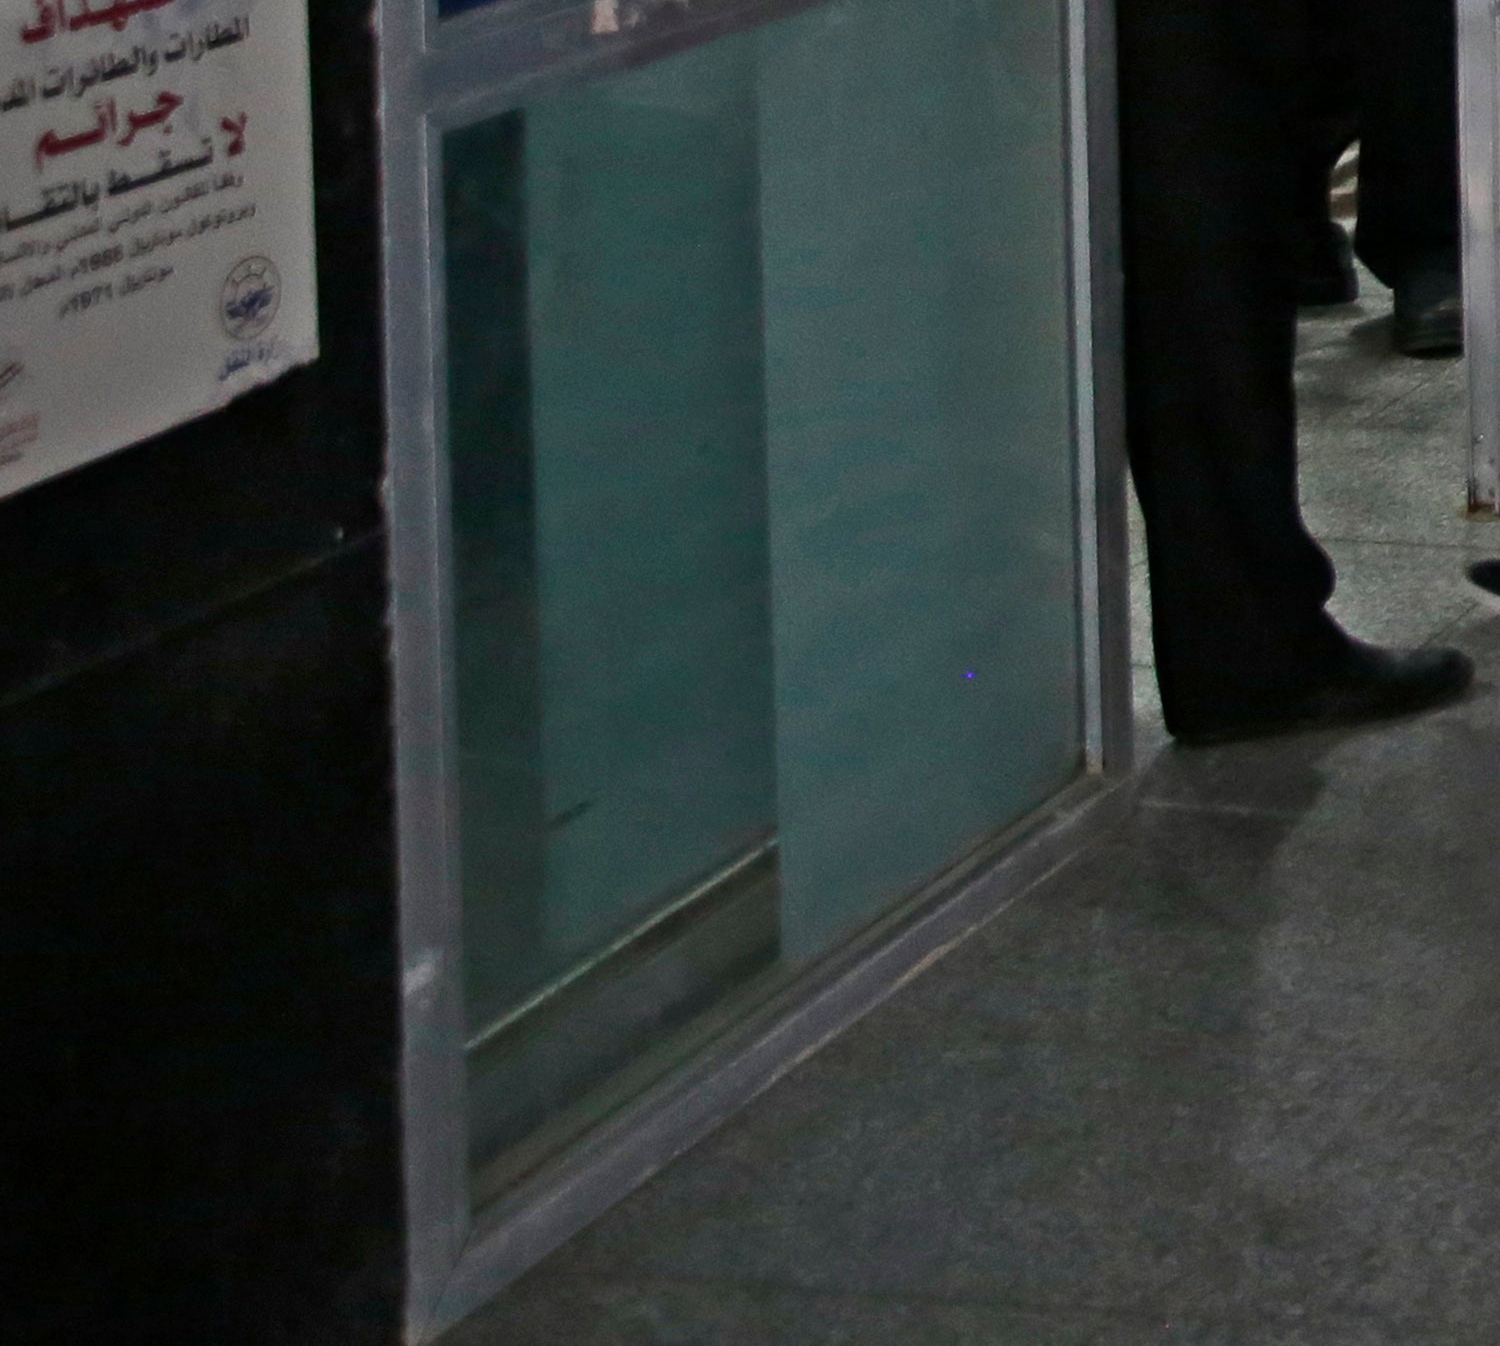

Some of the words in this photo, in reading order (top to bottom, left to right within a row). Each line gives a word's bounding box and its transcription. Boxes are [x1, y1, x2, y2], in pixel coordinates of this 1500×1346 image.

[163, 15, 250, 62] المطارات
[41, 43, 159, 100] والطائرات
[34, 90, 185, 174] جرائم
[220, 110, 248, 158] لا
[106, 135, 215, 197] تسقط
